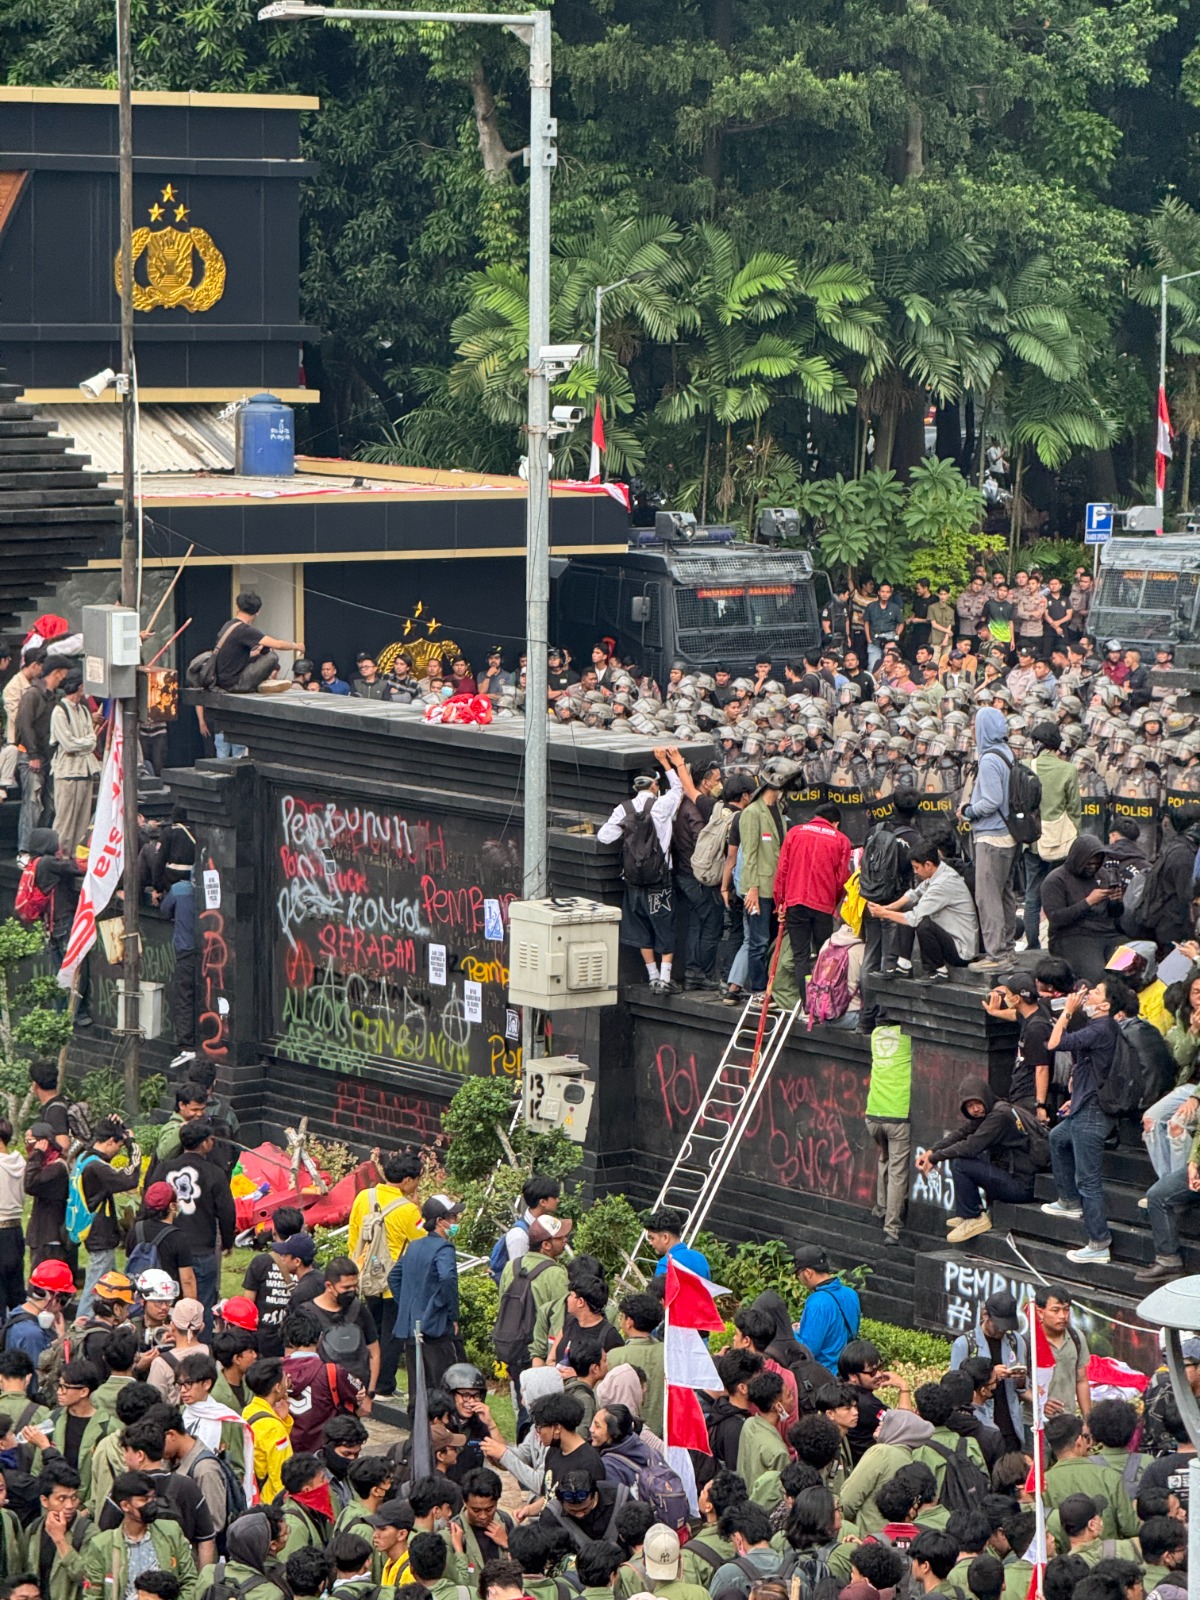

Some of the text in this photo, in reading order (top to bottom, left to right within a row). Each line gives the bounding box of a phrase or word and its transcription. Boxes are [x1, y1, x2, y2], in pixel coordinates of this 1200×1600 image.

[1092, 506, 1107, 529] P
[789, 789, 821, 802] OLISI
[827, 791, 863, 805] POLISI
[1115, 803, 1153, 817] POLISI
[529, 1073, 545, 1098] 13
